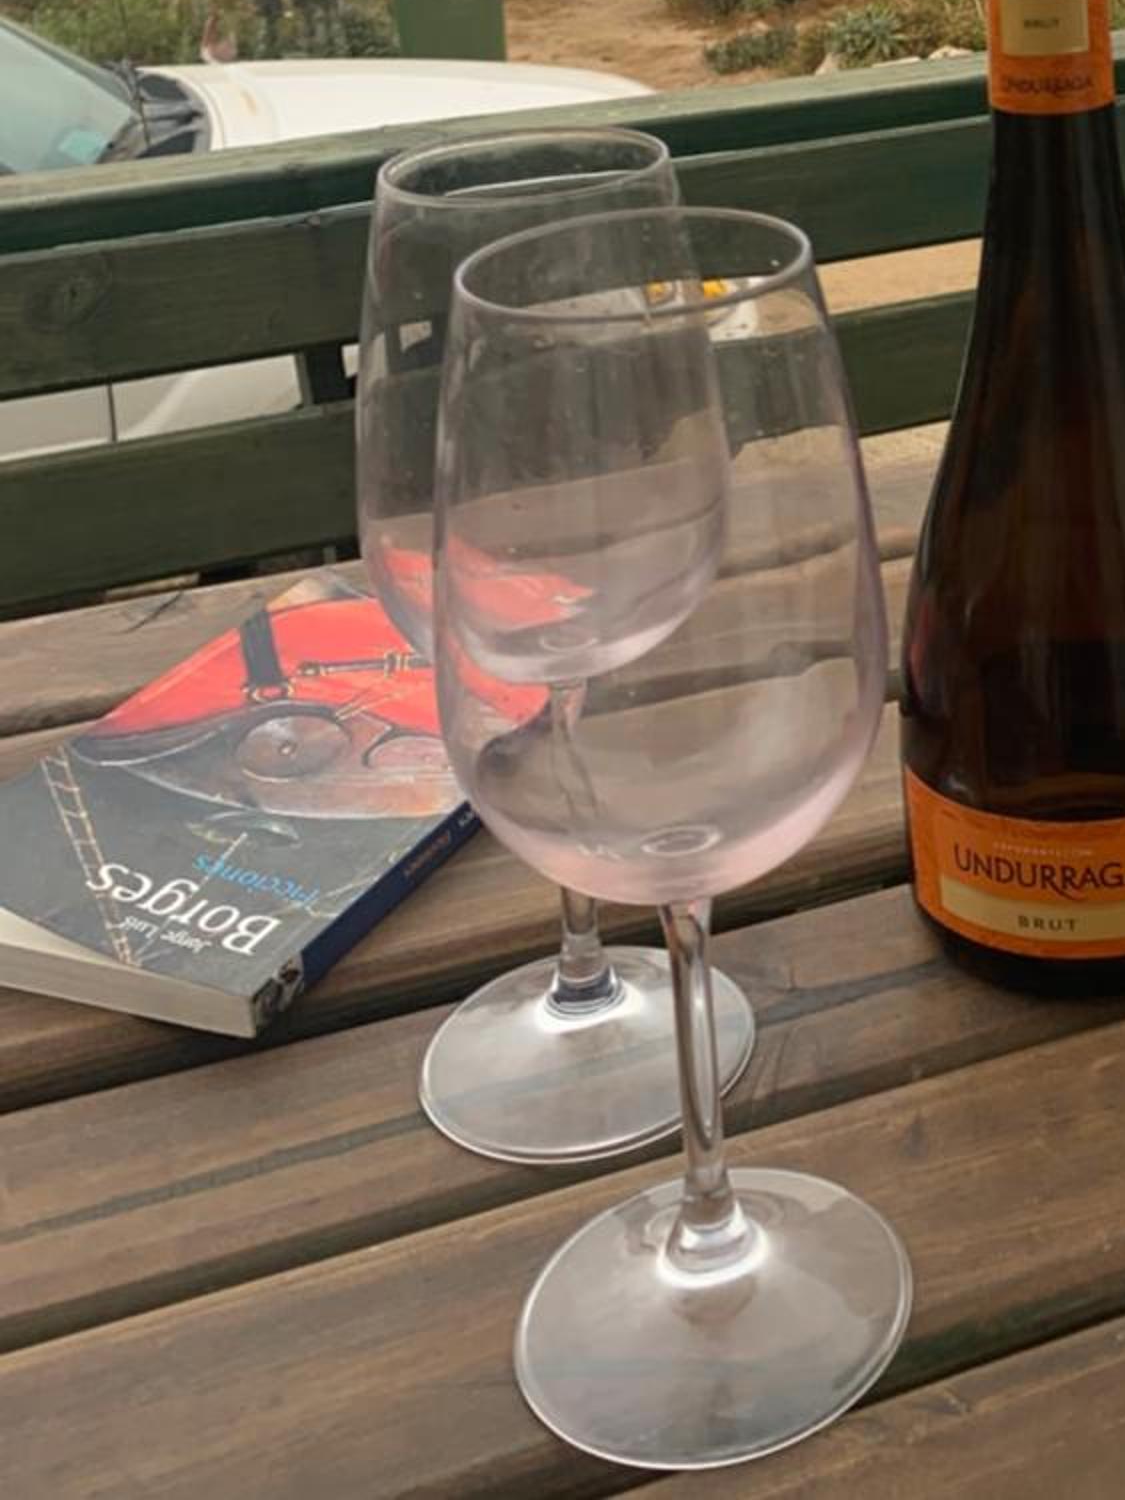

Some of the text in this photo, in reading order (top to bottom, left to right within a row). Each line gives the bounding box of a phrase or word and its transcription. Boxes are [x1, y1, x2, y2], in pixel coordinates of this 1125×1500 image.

[86, 862, 282, 956] Borges
[1018, 914, 1079, 932] BRUT
[122, 915, 212, 954] Jorge Luis
